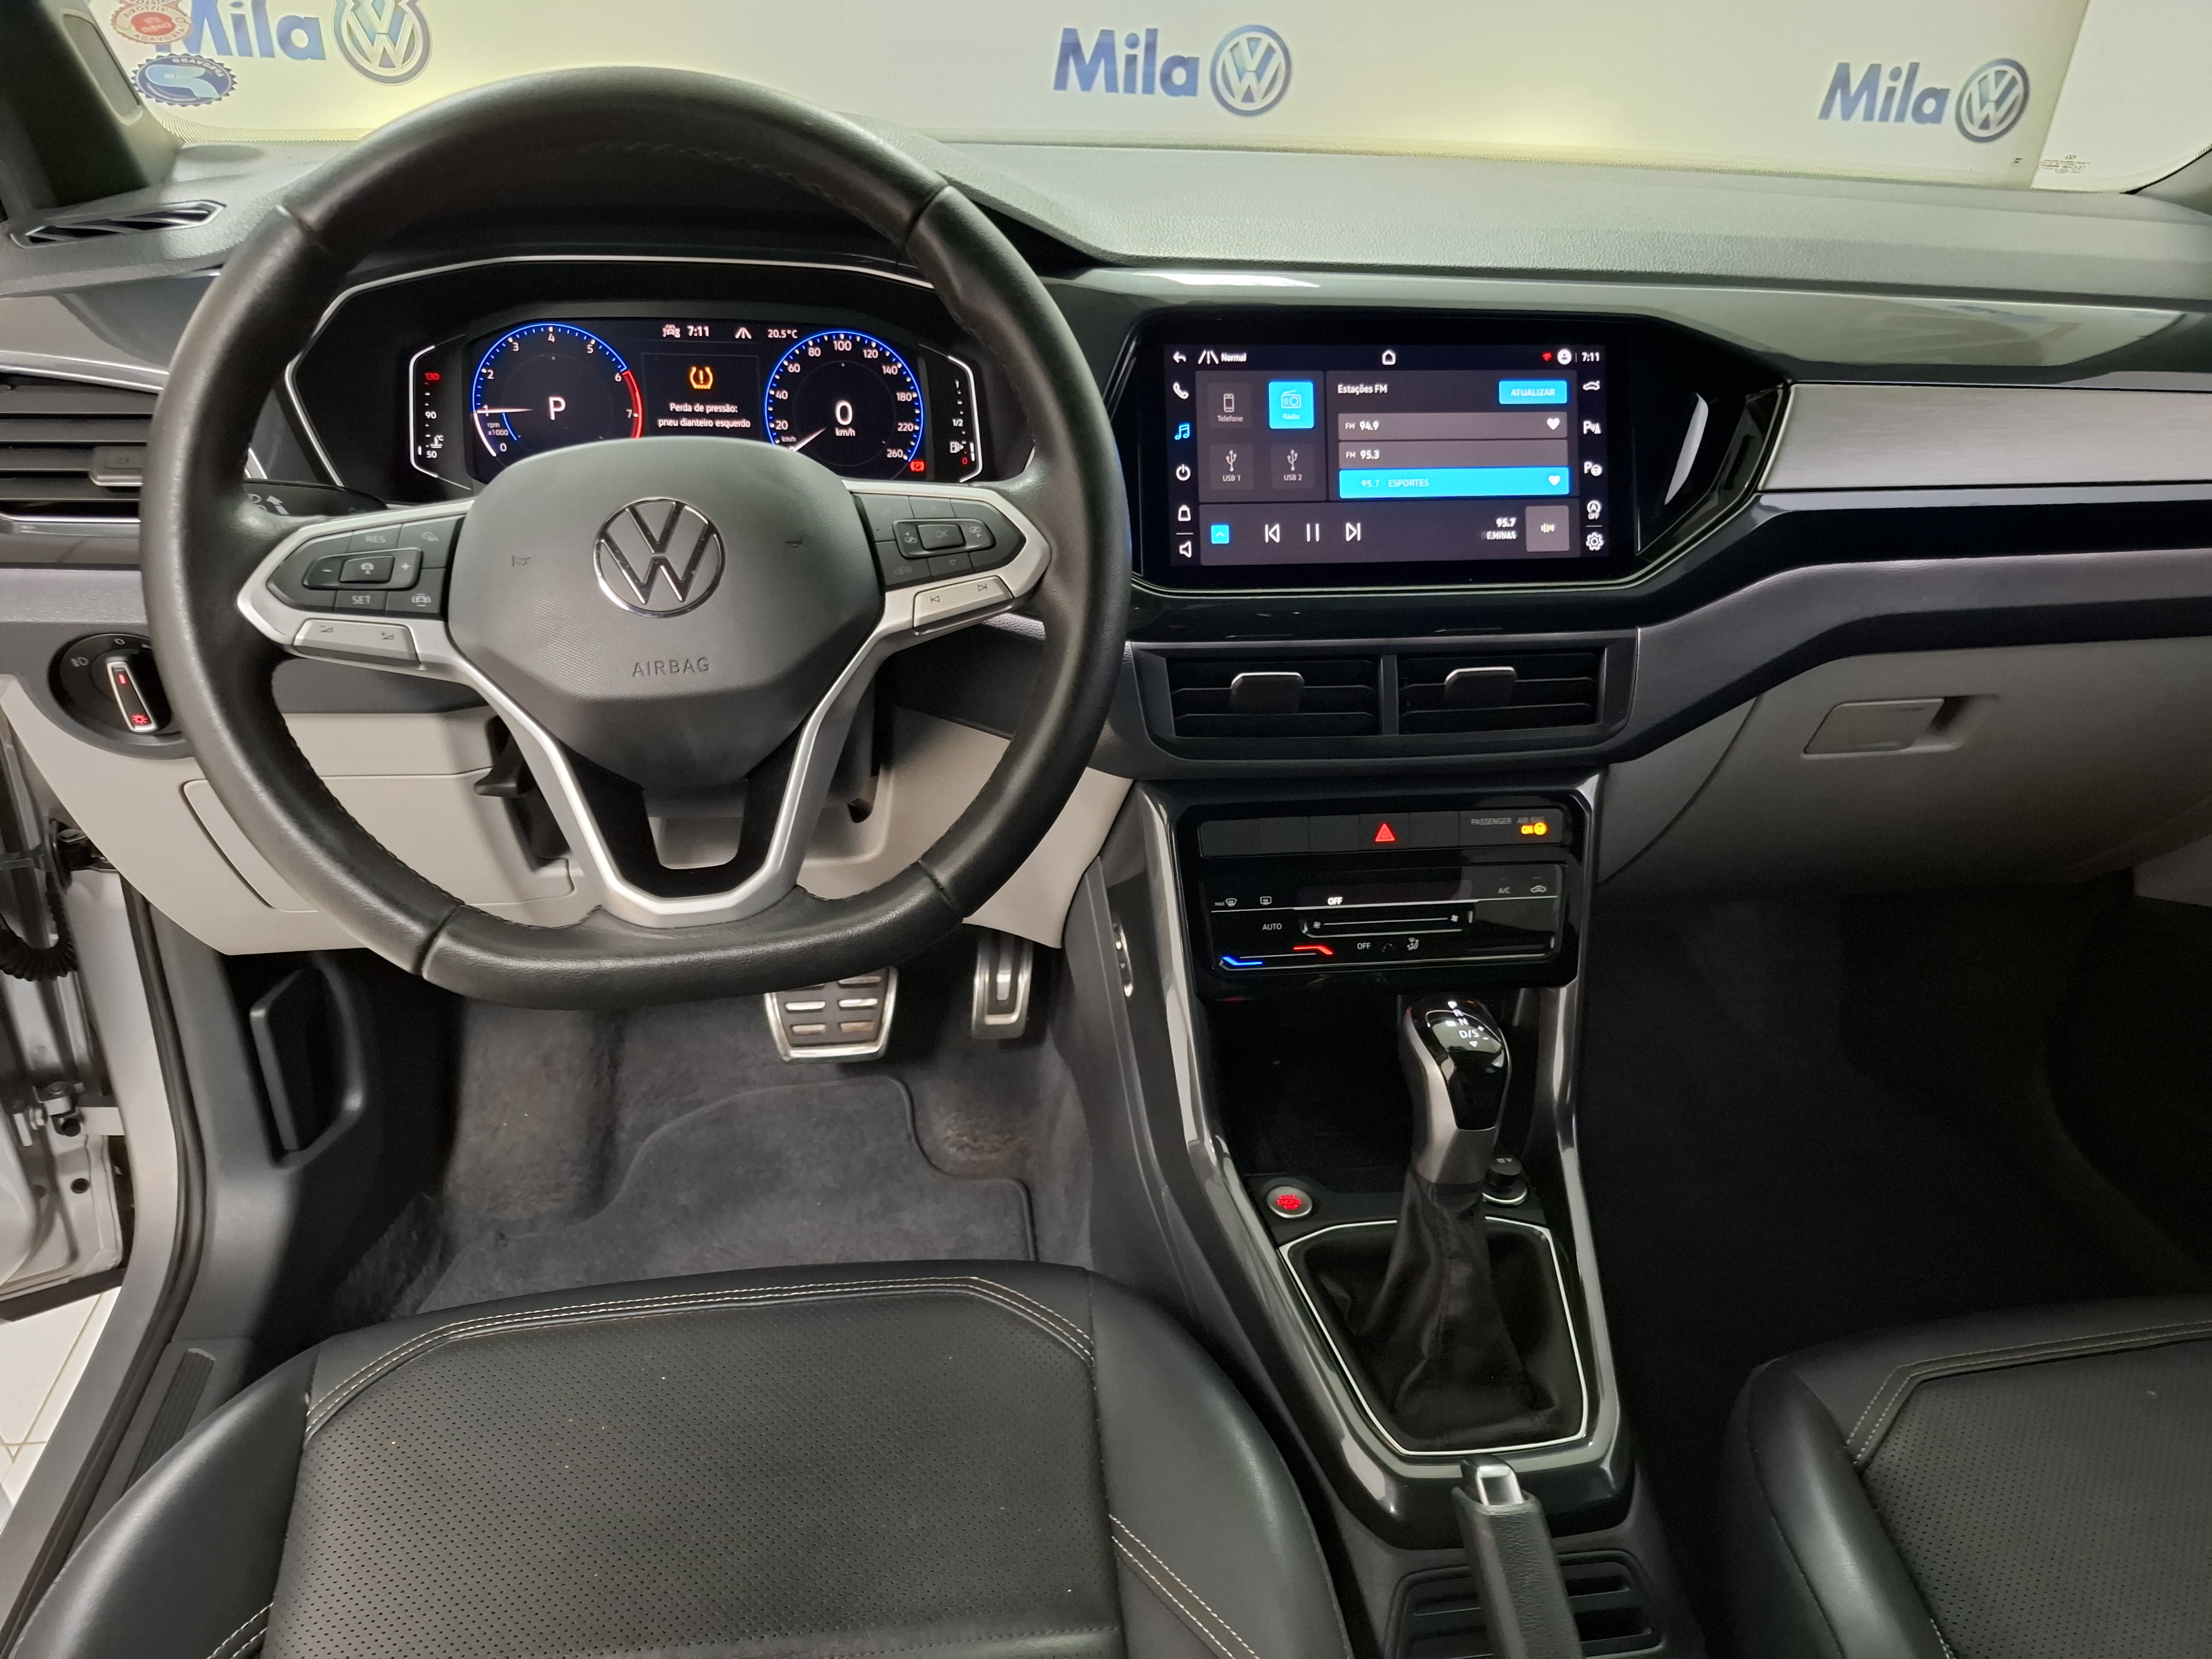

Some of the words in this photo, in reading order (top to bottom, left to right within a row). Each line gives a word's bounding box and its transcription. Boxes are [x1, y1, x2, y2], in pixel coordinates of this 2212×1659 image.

[1053, 28, 1199, 97] Mila
[1818, 62, 1951, 125] Mila
[687, 325, 709, 337] 7:11
[768, 329, 798, 339] 20.5°C
[548, 333, 556, 343] 4
[512, 342, 519, 352] 3
[587, 344, 594, 354] 5
[833, 340, 852, 351] 100
[808, 347, 821, 357] 80
[863, 349, 878, 358] 120
[1221, 352, 1246, 362] Normal
[1581, 352, 1599, 362] 7:11
[788, 363, 801, 373] 60
[882, 364, 898, 375] 140
[487, 370, 494, 380] 2
[615, 373, 622, 382] 6
[1338, 384, 1373, 395] Estações
[1374, 385, 1387, 394] FM
[1511, 388, 1555, 396] ATUALIZAR
[775, 390, 788, 400] 40
[896, 392, 912, 402] 180
[548, 396, 566, 420] P
[669, 402, 692, 412] Perda
[694, 403, 704, 412] de
[425, 411, 437, 419] 90
[626, 409, 633, 419] 7
[835, 400, 853, 425] 0
[658, 419, 679, 428] pneu
[680, 418, 713, 427] dianteiro
[715, 419, 751, 429] esquerdo
[952, 418, 963, 427] 1/2
[1217, 415, 1244, 423] Telefone
[775, 420, 788, 430] 20
[897, 422, 914, 432] 220
[1359, 421, 1379, 431] 94.9
[835, 427, 856, 436] km/h
[499, 442, 507, 452] 0
[426, 451, 438, 459] 50
[886, 449, 903, 458] 260
[1360, 451, 1380, 460] 95.3
[1388, 479, 1429, 488] ESPORTES
[1496, 517, 1517, 528] 95.7
[365, 535, 385, 543] RES
[1493, 530, 1516, 540] MINAS
[351, 595, 371, 605] SET
[632, 657, 710, 678] AIRBAG
[1327, 897, 1343, 905] OFF
[1453, 1009, 1464, 1017] R
[1458, 1018, 1469, 1026] N
